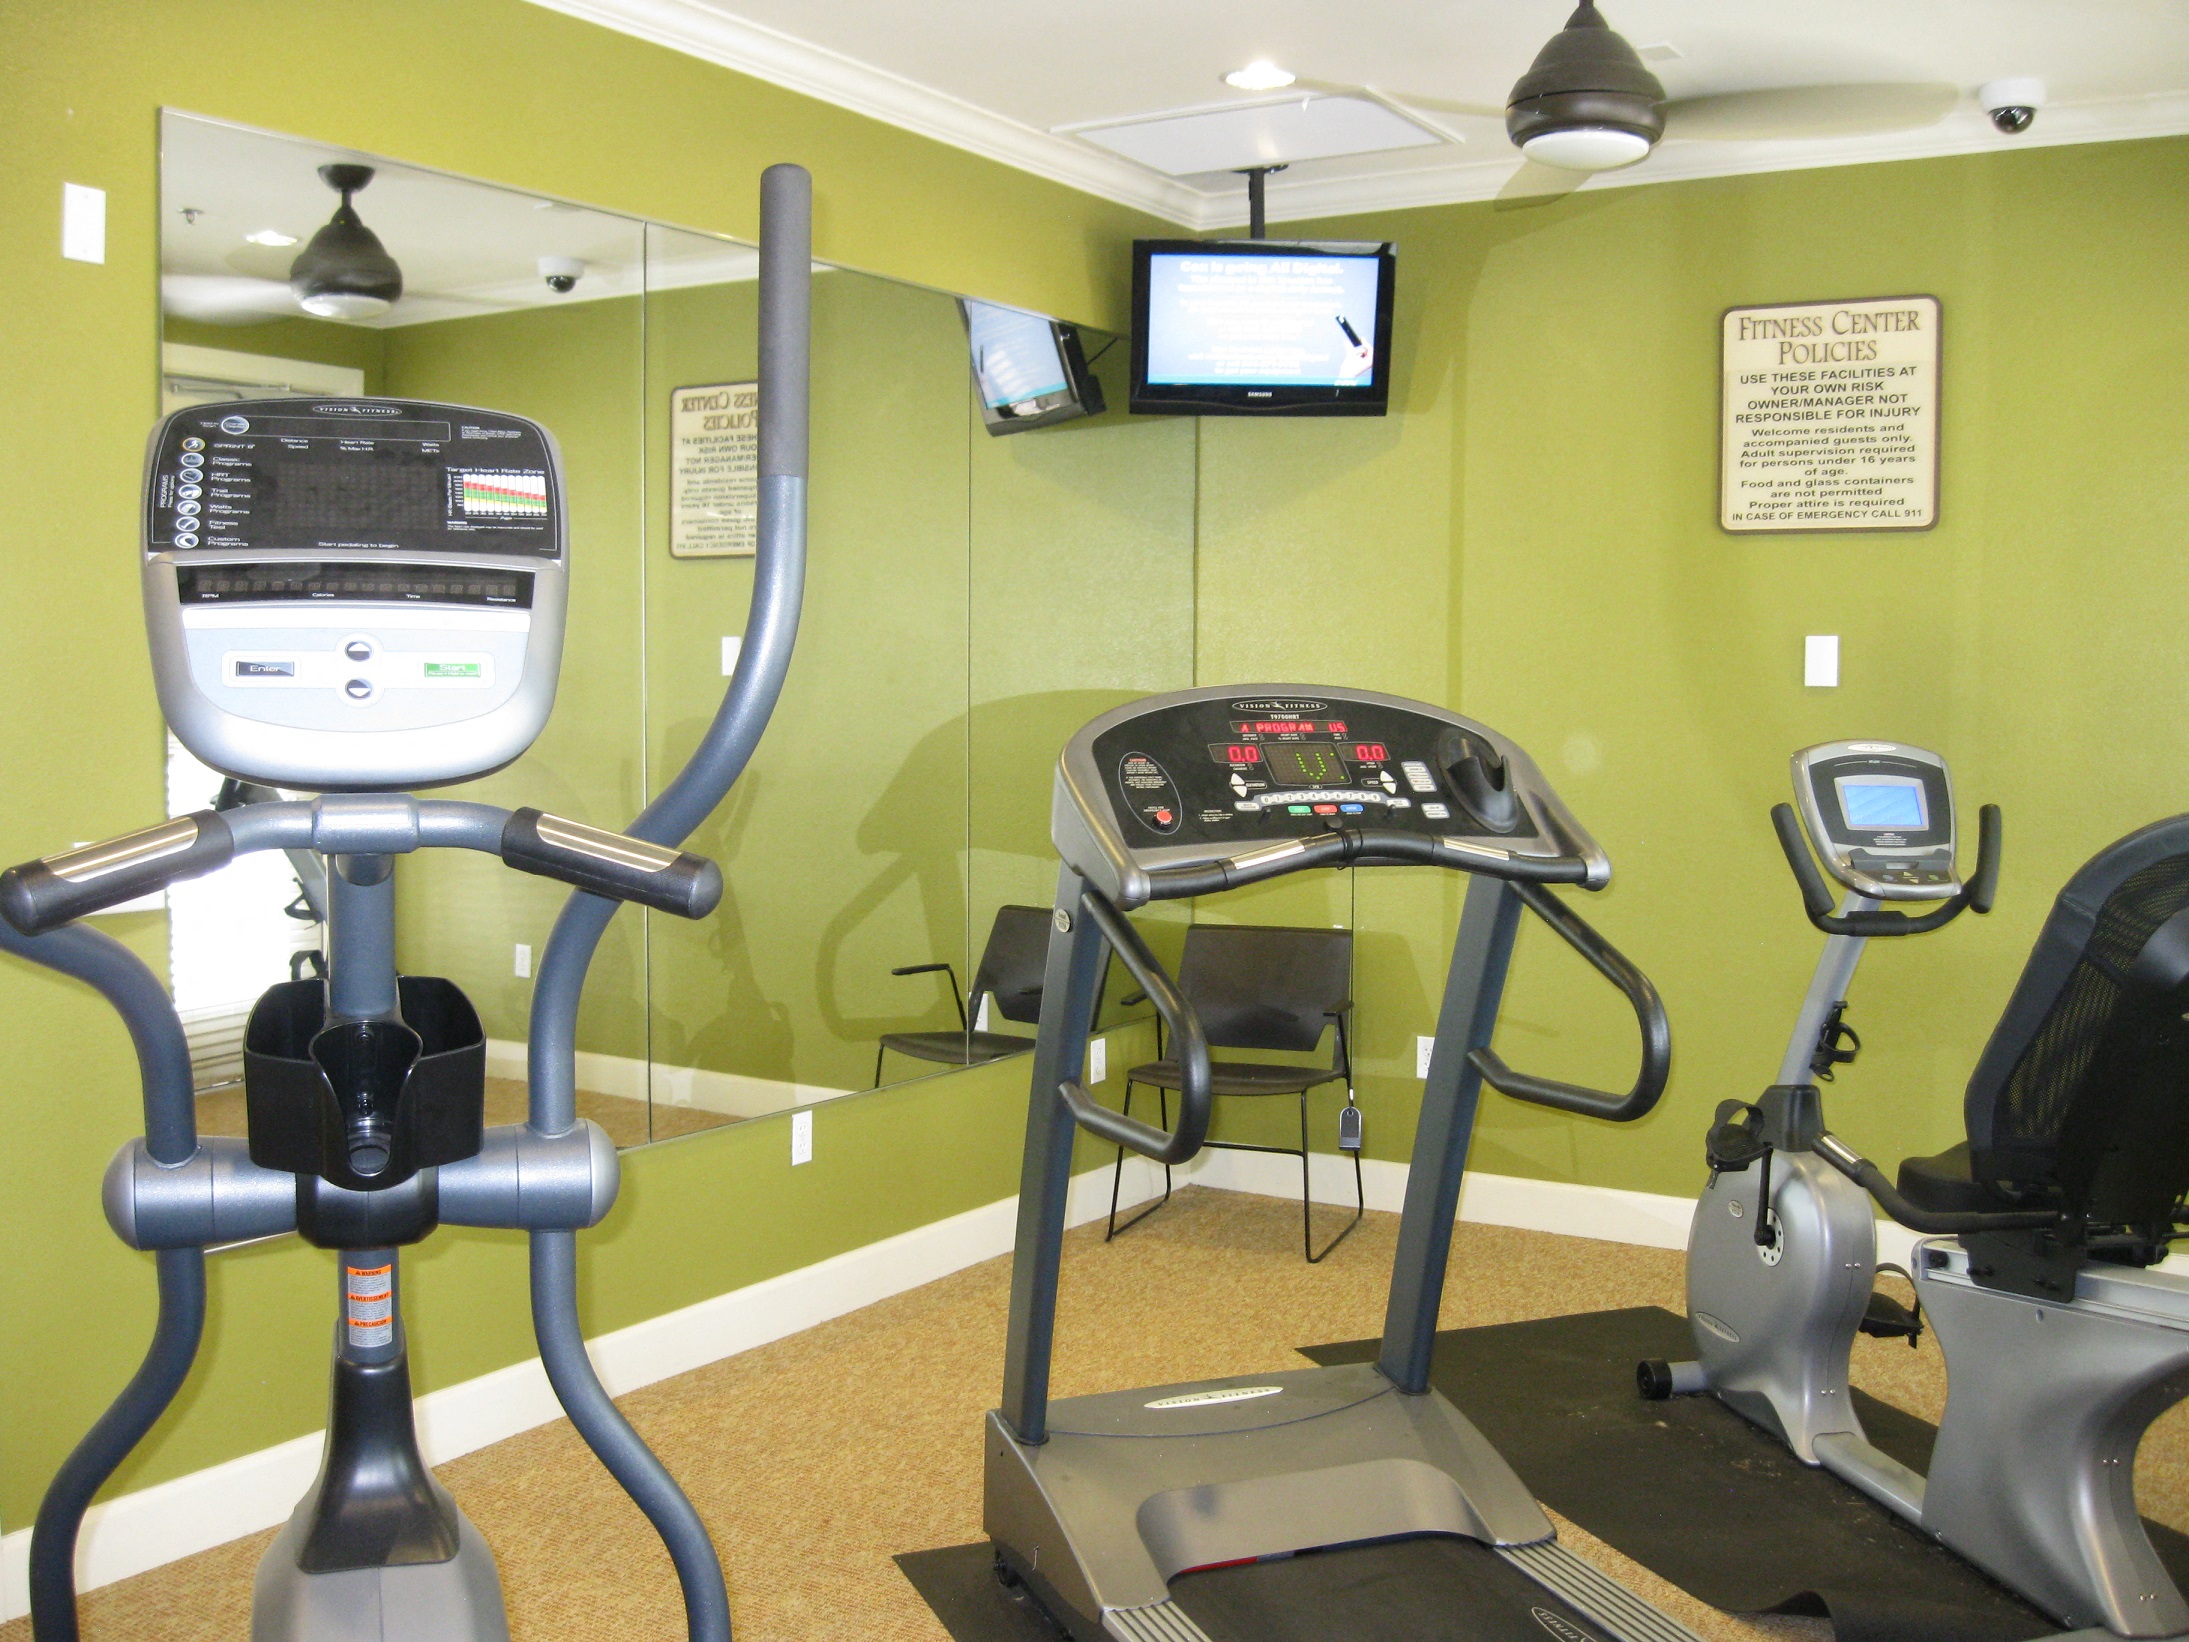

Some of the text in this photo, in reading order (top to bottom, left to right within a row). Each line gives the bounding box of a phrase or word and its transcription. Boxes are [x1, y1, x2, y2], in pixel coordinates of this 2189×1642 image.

[1738, 310, 1920, 341] FITNESS CENTER
[1778, 340, 1877, 365] POLICIES
[1740, 366, 1917, 384] USE THESE FACILITIES AT
[1771, 381, 1884, 396] YOUR OWN RISK
[1748, 394, 1908, 410] OWNER/MANAGER NOT
[1736, 406, 1920, 424] RESPONSIBLE FOR INJURY
[1752, 424, 1904, 437] Welcome residents and
[1744, 437, 1829, 448] accompanied
[1834, 436, 1877, 446] guests
[1740, 445, 1915, 458] Adult supervision required
[1740, 456, 1916, 468] for persons under 16 years
[1804, 468, 1818, 476] of
[1741, 476, 1914, 488] Food and glass containers
[1820, 488, 1882, 498] permitted
[1749, 498, 1904, 510] Proper attire is required
[1746, 512, 1776, 520] CASE
[1778, 512, 1794, 520] OF
[1797, 510, 1868, 520] EMERGENCY
[1871, 509, 1902, 518] CALL
[1904, 509, 1922, 518] 911
[250, 664, 282, 672] Enter
[1256, 722, 1315, 732] PROGRAM
[1228, 746, 1259, 763] 0.0
[1356, 744, 1385, 761] 0.0
[1158, 1398, 1200, 1406] VISION
